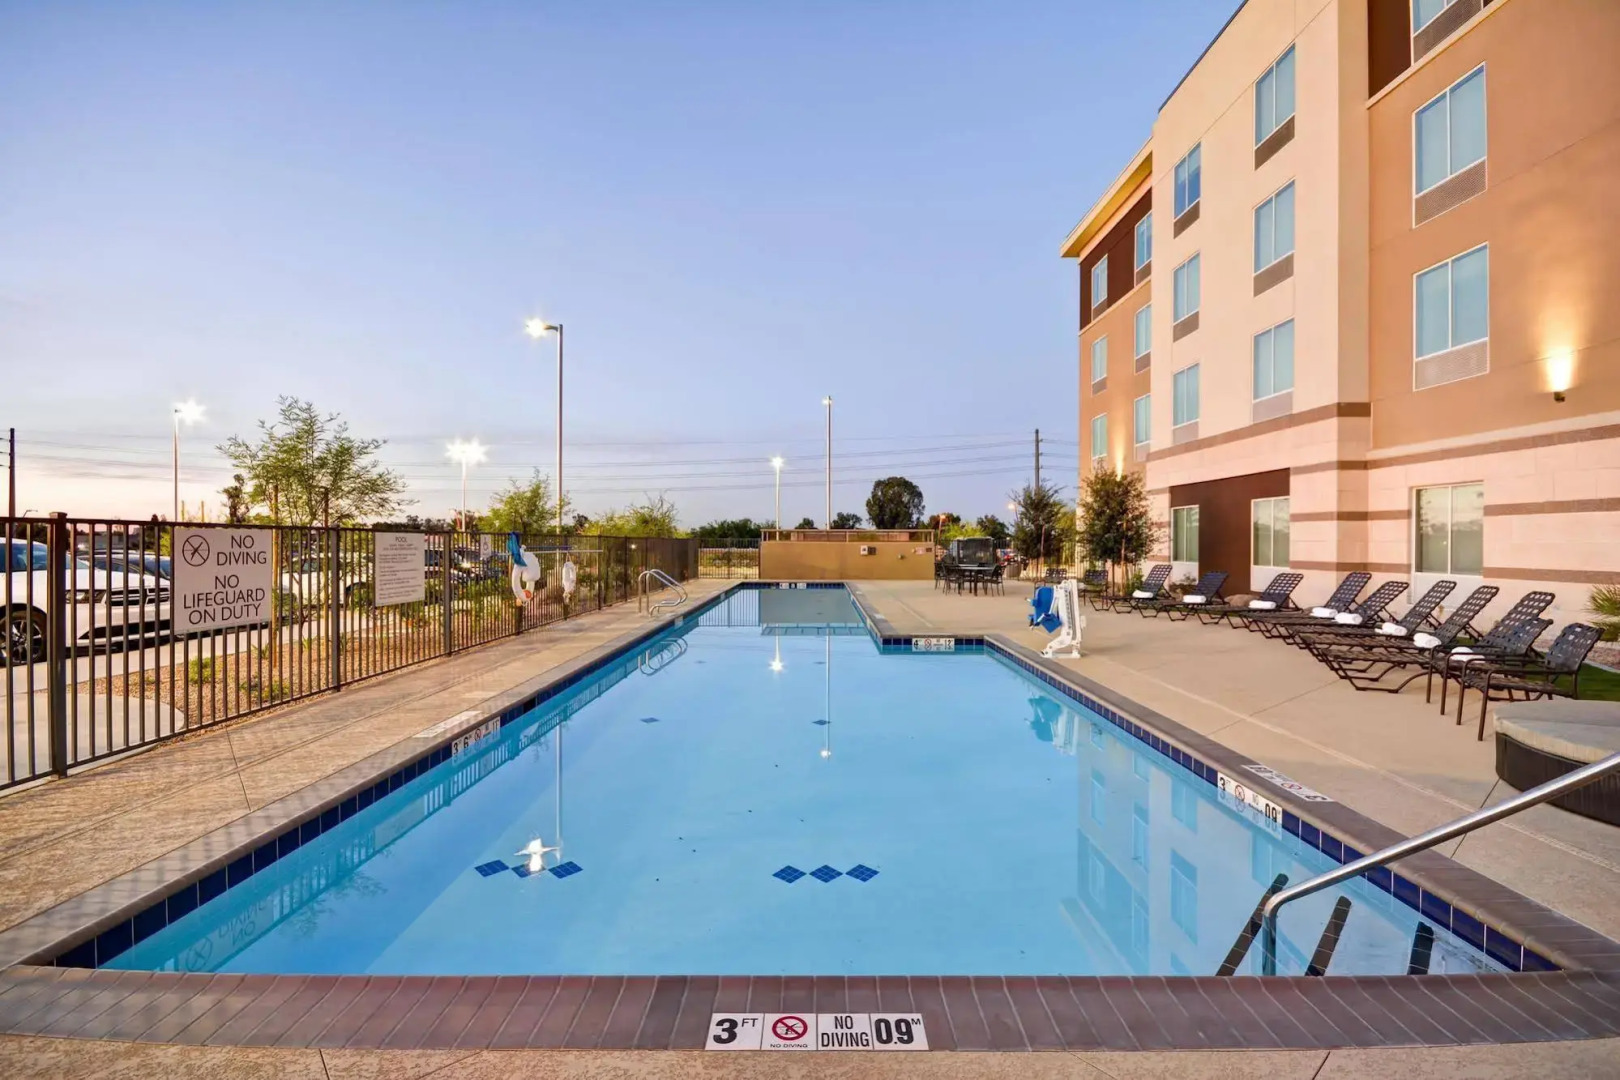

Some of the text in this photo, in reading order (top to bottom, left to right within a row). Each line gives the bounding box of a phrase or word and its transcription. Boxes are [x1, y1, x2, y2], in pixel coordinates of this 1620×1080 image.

[231, 535, 254, 549] NO
[217, 551, 267, 566] DIVING
[215, 574, 239, 590] NO
[183, 588, 265, 609] LIFEGUARD
[188, 602, 261, 625] ON DUTY
[712, 1017, 758, 1044] 3 FT
[834, 1015, 853, 1030] NO
[821, 1032, 870, 1047] DIVING
[875, 1018, 921, 1045] 0.9 M
